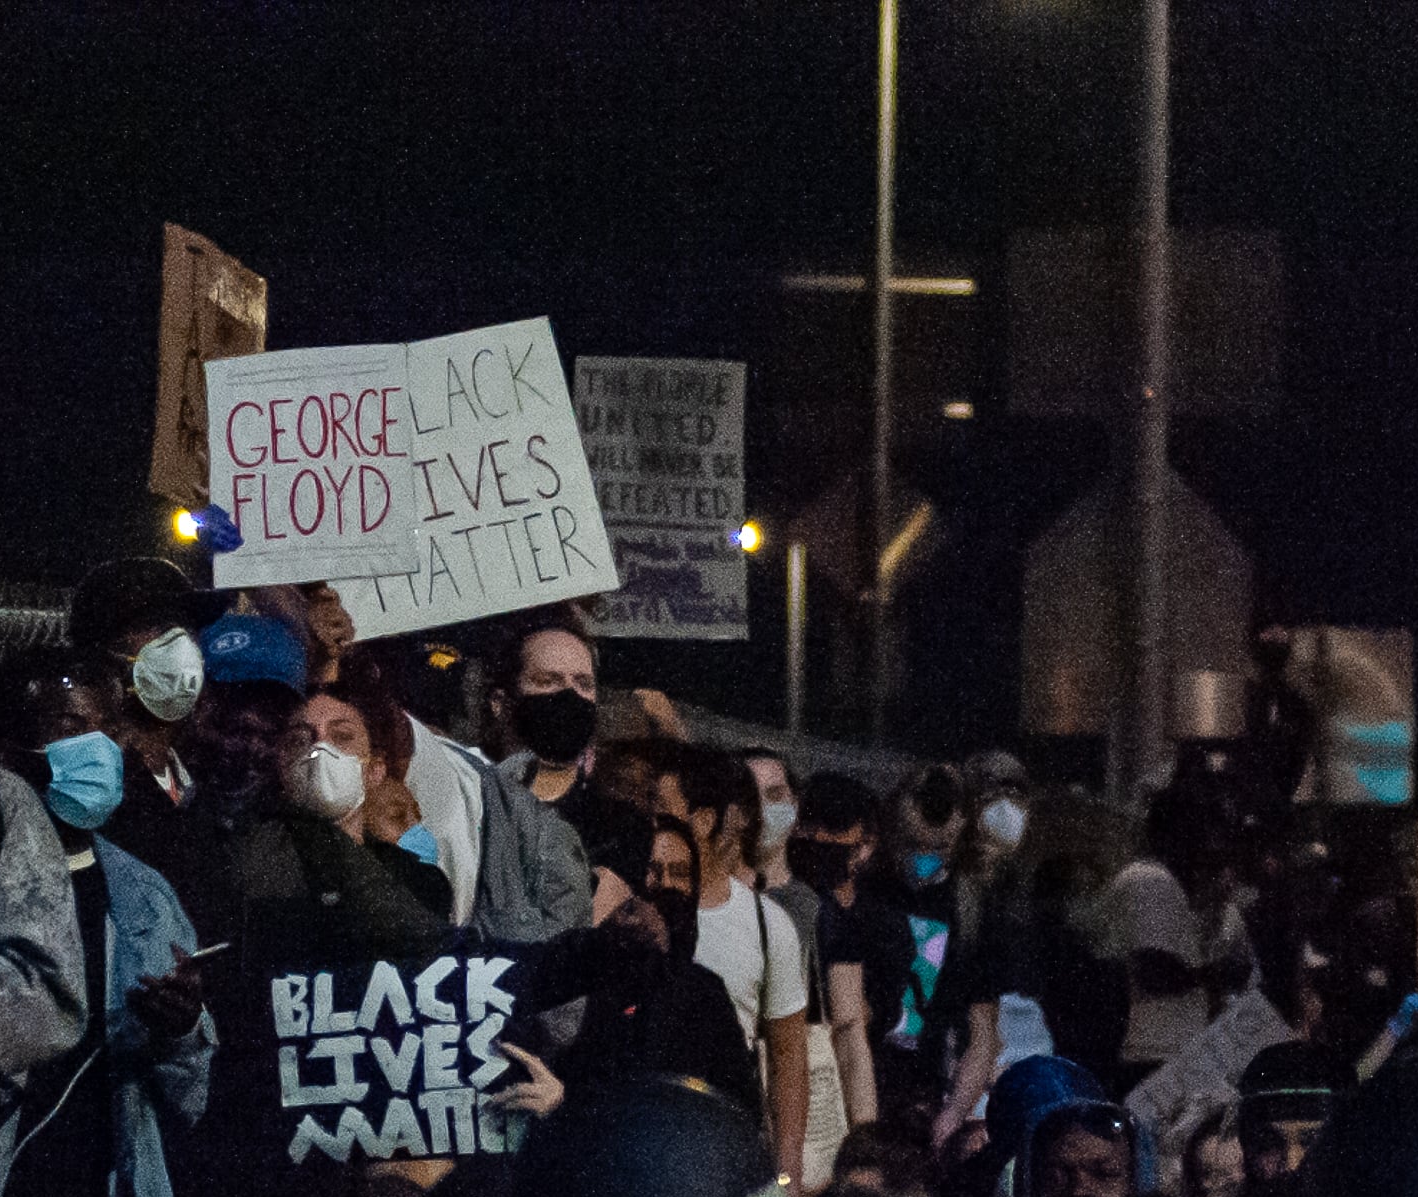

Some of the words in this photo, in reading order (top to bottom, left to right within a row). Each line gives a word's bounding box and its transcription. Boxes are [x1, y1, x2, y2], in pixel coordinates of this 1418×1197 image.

[226, 387, 408, 469] GEORGE
[408, 342, 551, 434] LACK
[232, 463, 392, 540] FLOYD
[413, 435, 562, 522] IVES
[271, 956, 518, 1038] BLACK
[278, 1012, 511, 1108] LIVES
